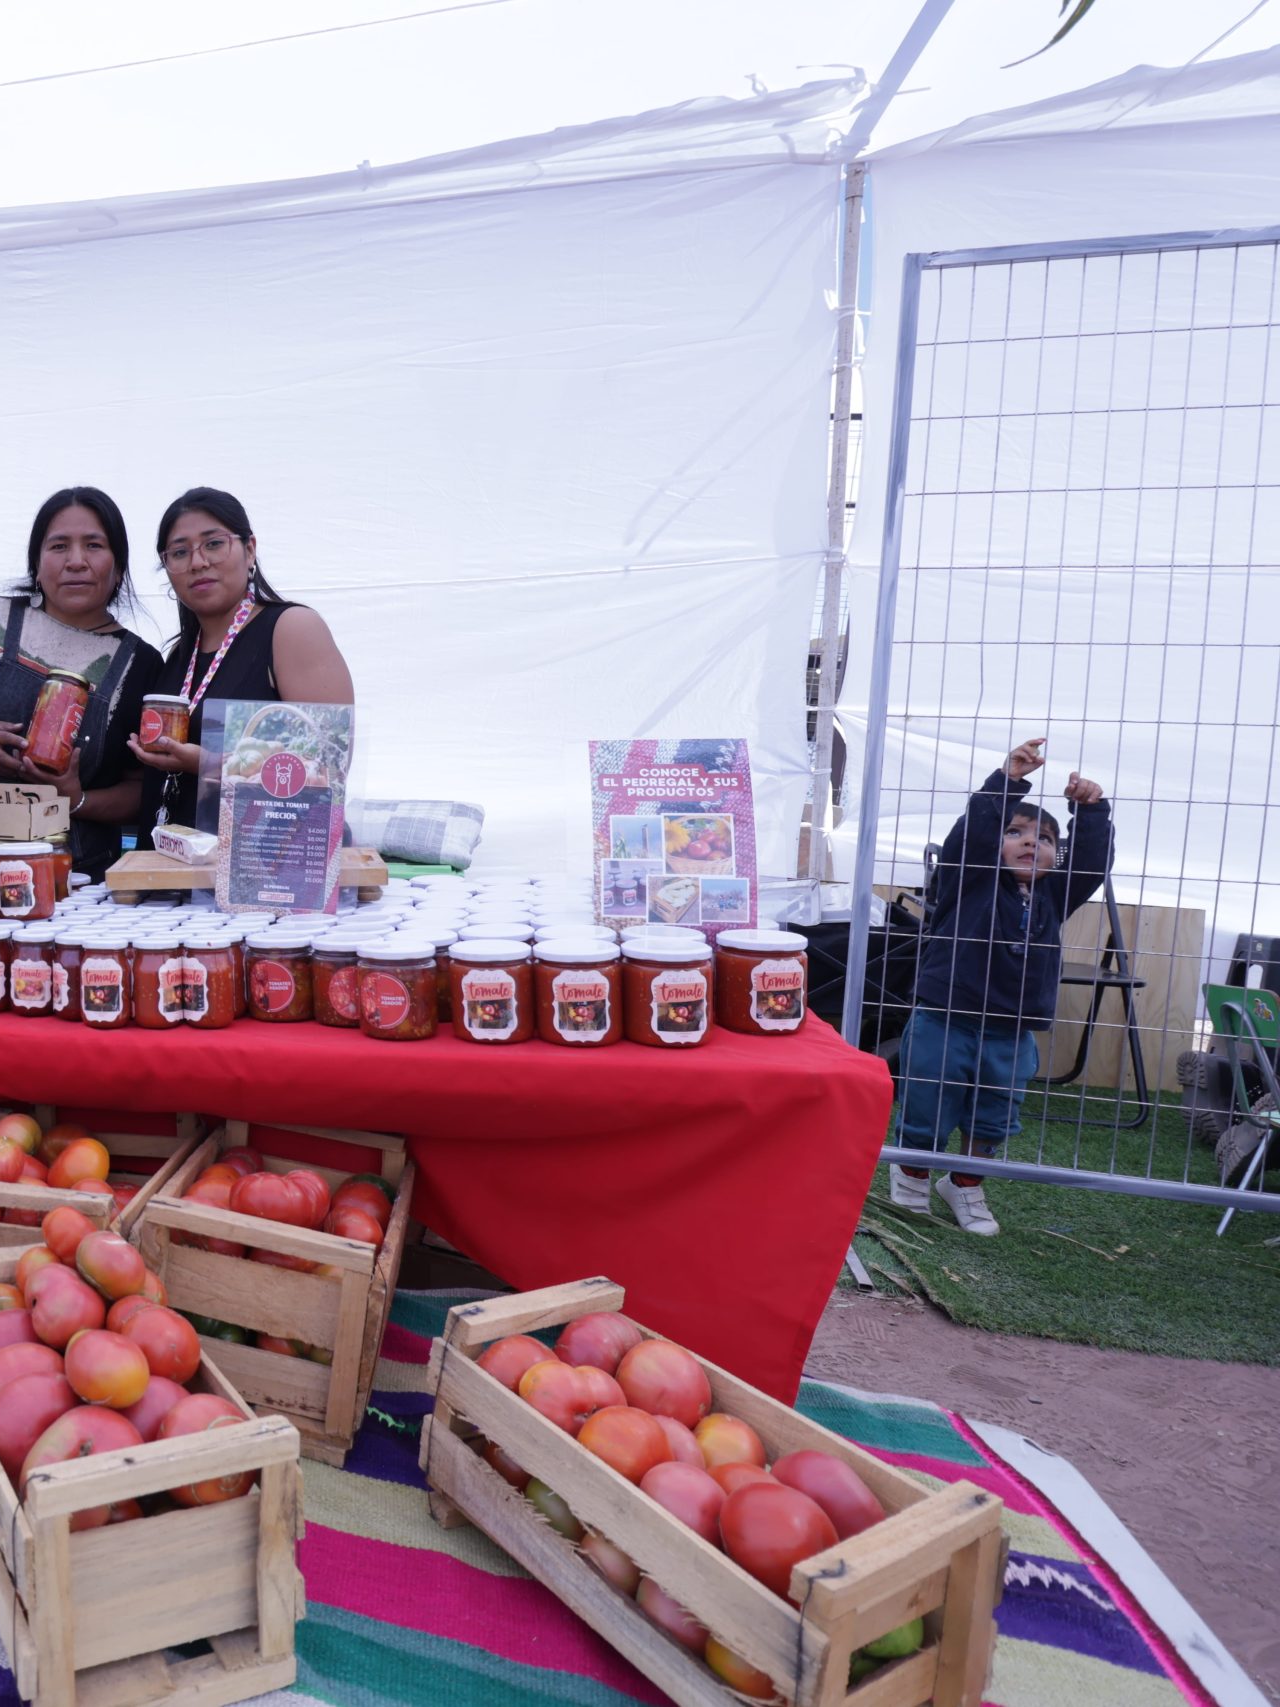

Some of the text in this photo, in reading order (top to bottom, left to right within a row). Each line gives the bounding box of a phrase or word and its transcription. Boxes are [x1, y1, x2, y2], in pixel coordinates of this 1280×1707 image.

[639, 767, 700, 777] CONOCE
[602, 777, 739, 787] EL PEDREGAL Y SUS
[627, 787, 715, 797] PRODUCTOS
[253, 800, 273, 808] FIESTA
[265, 811, 297, 820] PRECIOS
[85, 968, 118, 984] tomate
[760, 971, 800, 990] tomate
[468, 981, 510, 999] tomate
[559, 982, 603, 1000] tomate
[660, 983, 704, 1001] tomate
